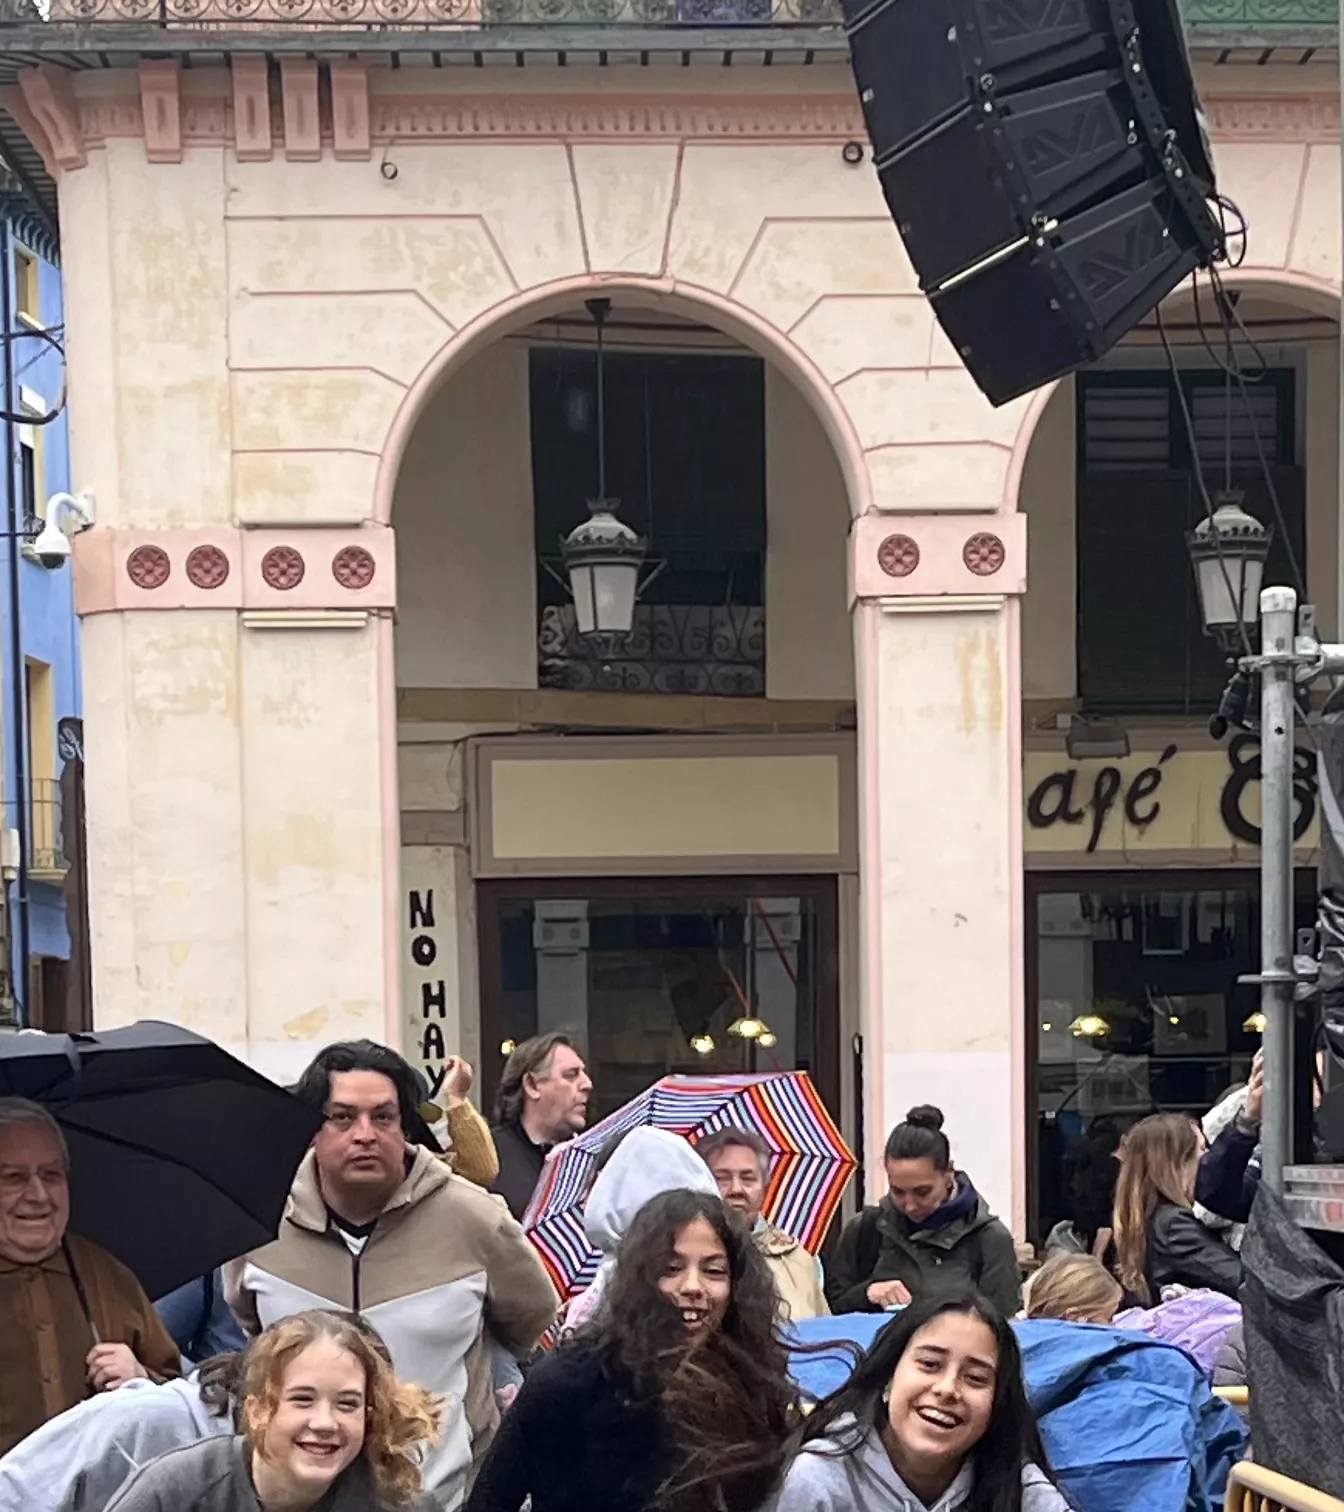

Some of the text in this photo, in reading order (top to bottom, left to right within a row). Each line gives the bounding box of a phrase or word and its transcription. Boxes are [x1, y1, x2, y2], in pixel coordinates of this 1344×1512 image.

[1026, 743, 1178, 854] afé
[408, 888, 448, 1100] NO HAY
